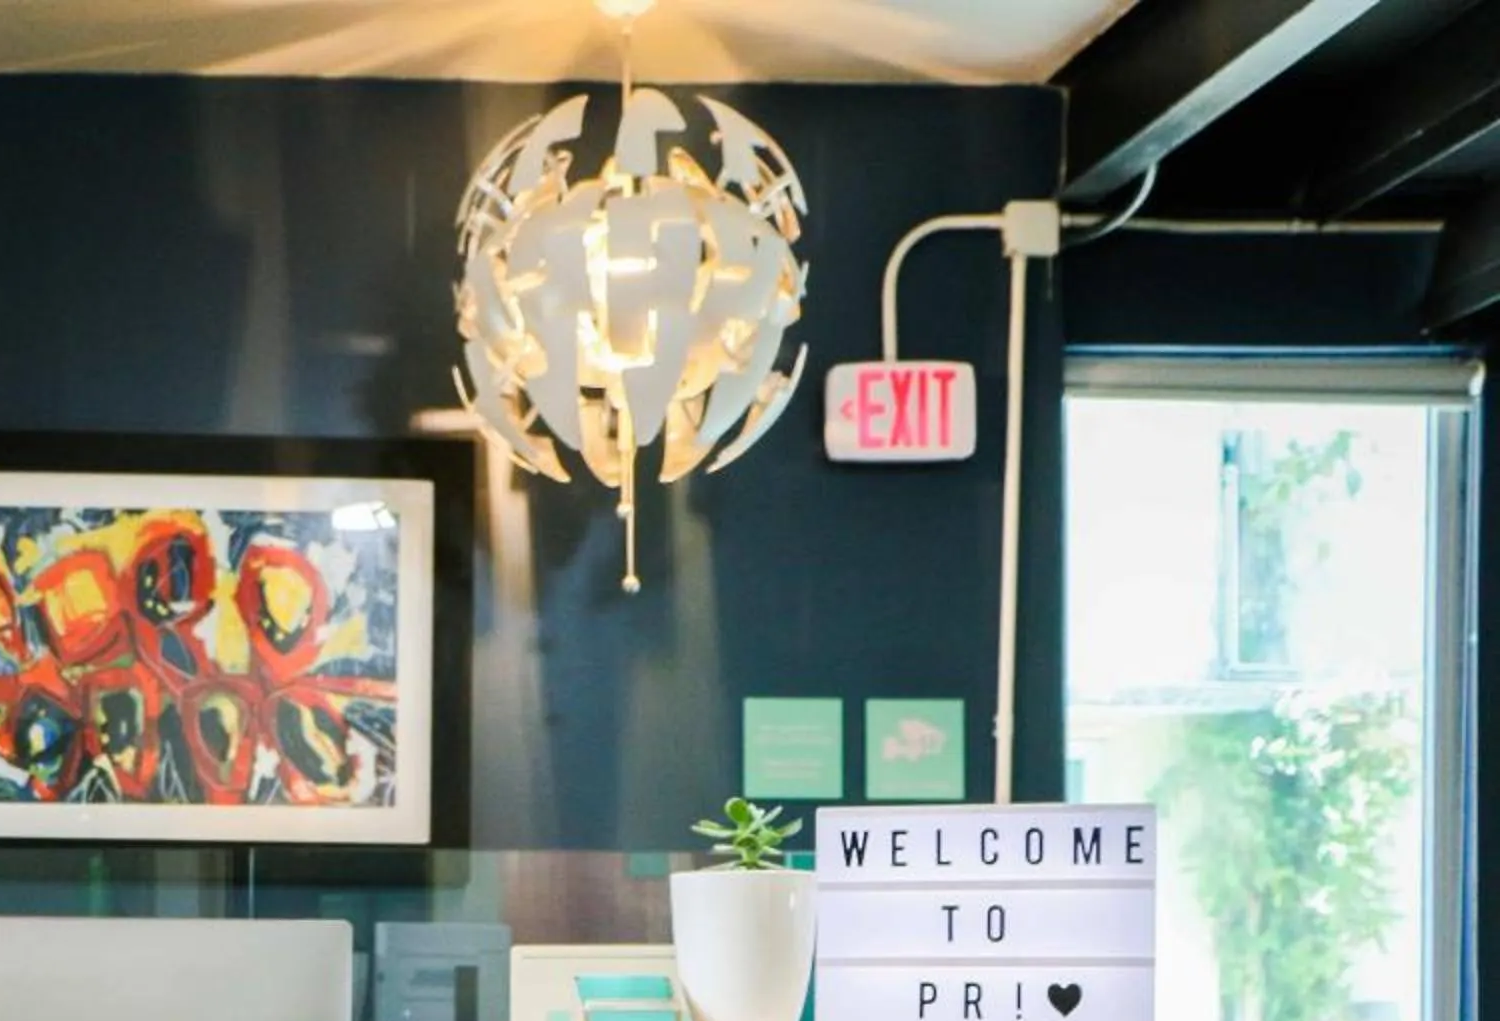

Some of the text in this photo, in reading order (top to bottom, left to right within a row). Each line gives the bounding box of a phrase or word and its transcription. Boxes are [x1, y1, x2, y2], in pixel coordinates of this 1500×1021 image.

[857, 369, 957, 449] EXIT
[840, 825, 1145, 867] WELCOME
[941, 904, 1006, 943] TO
